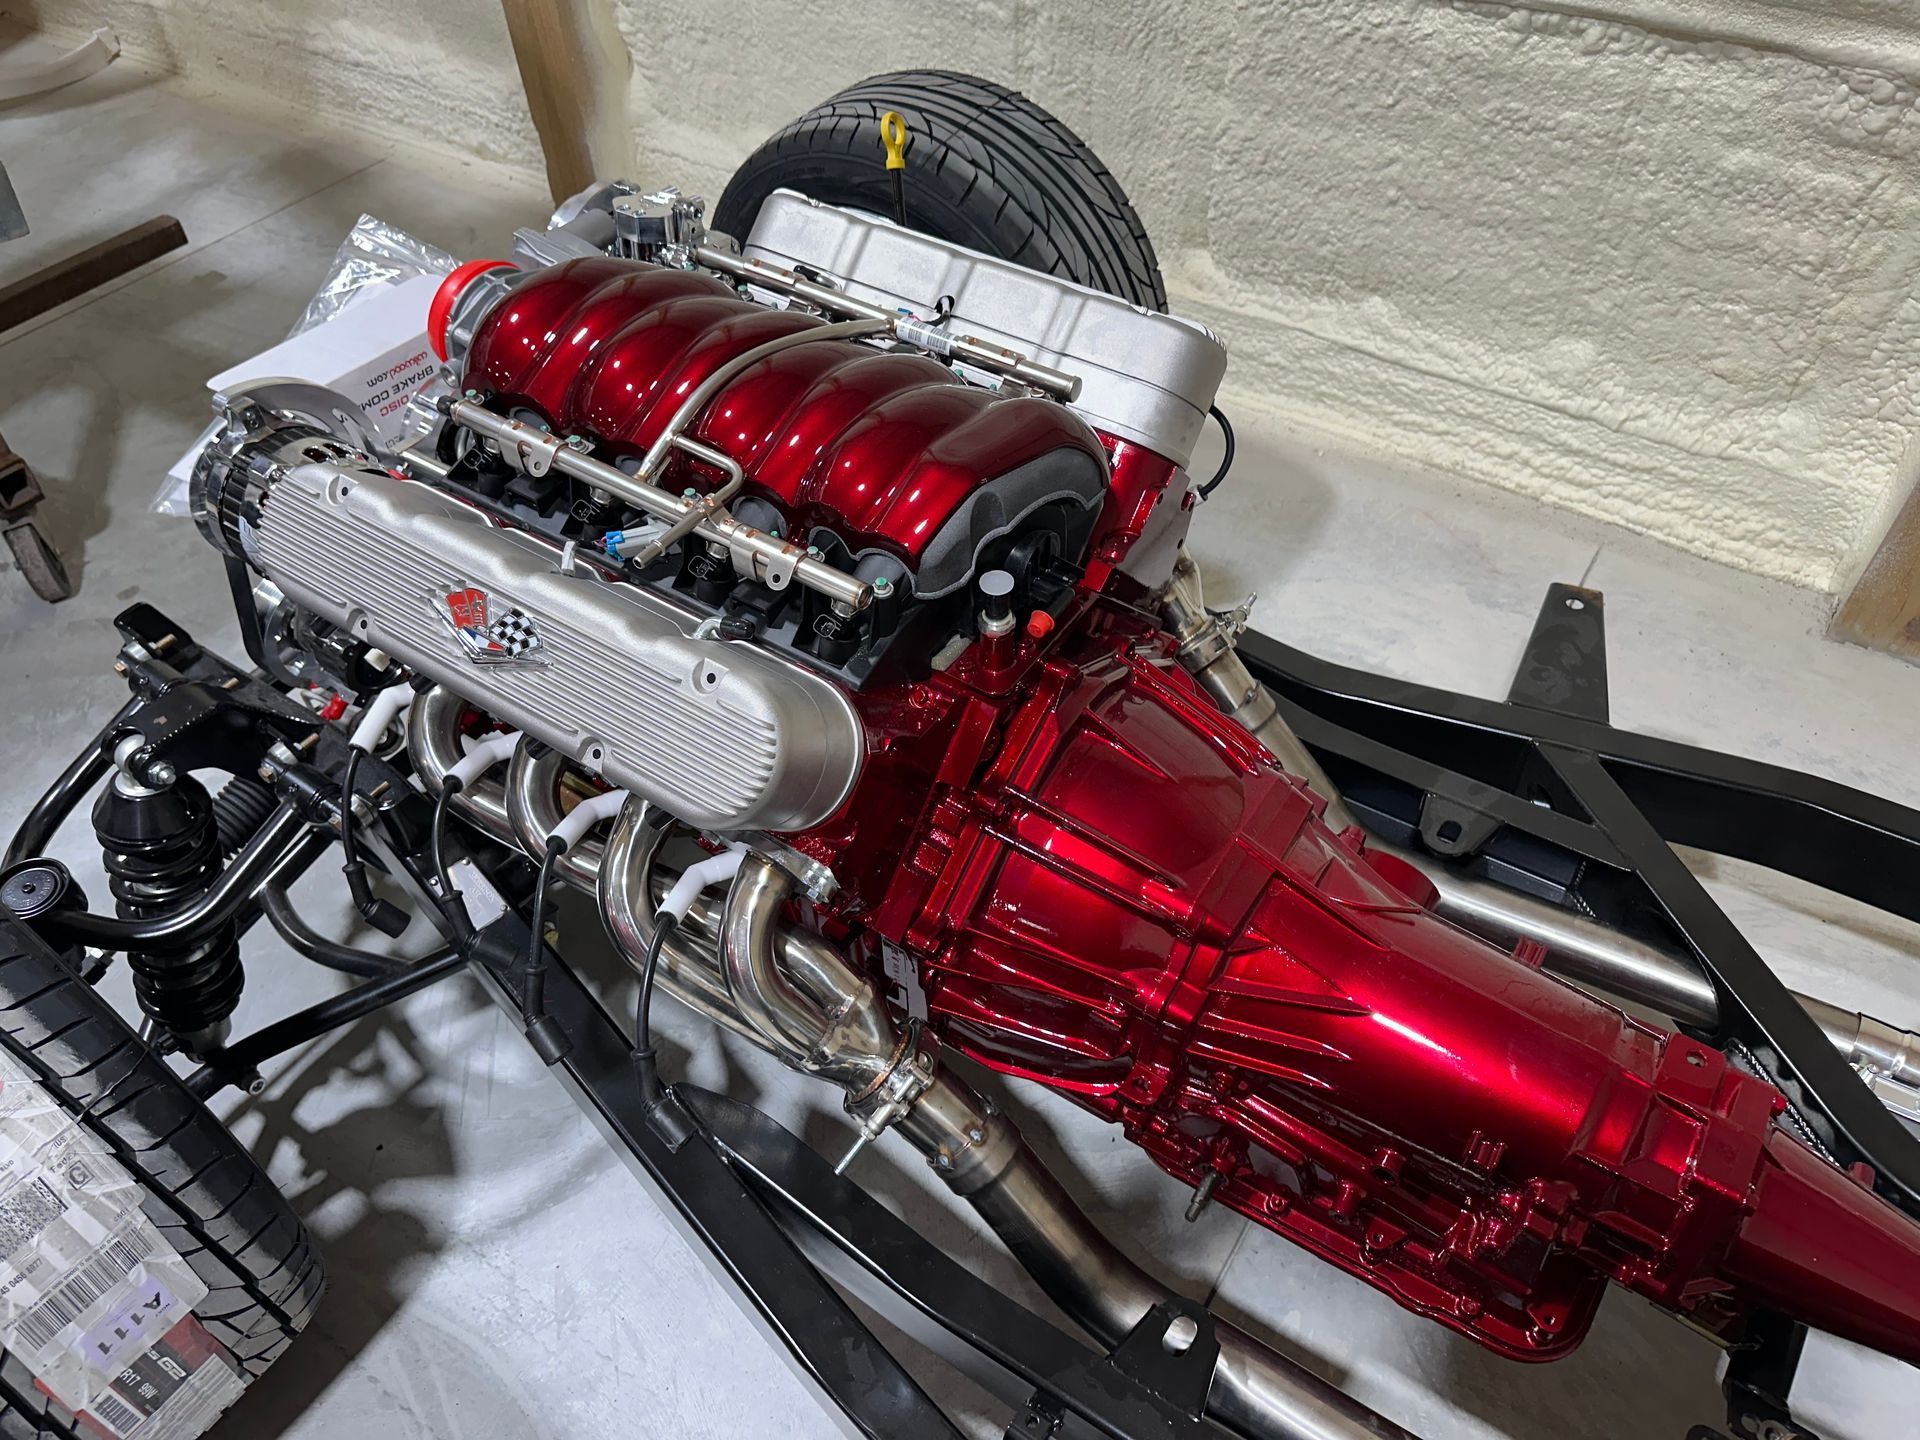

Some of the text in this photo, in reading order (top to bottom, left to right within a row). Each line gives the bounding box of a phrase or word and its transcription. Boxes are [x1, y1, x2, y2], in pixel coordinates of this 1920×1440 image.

[366, 351, 428, 388] wilwood.com
[360, 365, 434, 412] BRAKE COM
[379, 394, 410, 417] DISC
[69, 1166, 87, 1185] G
[8, 1271, 27, 1288] 0456
[138, 1382, 158, 1400] 99W
